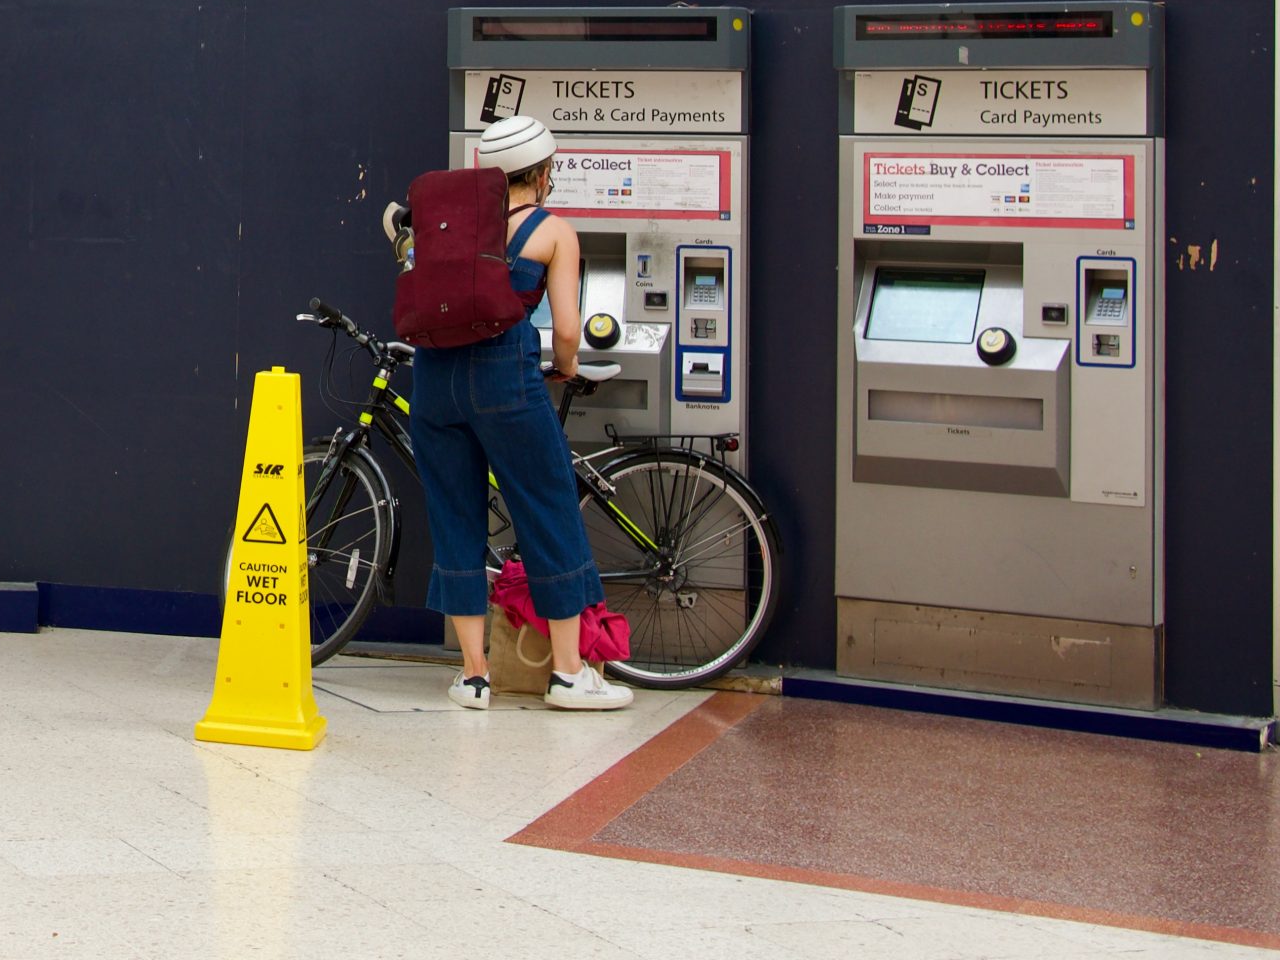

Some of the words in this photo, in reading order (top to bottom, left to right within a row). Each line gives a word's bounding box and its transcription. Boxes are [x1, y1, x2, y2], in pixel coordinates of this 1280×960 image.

[552, 81, 635, 98] TICKETS
[980, 81, 1068, 99] TICKETS
[552, 108, 588, 121] Cash
[594, 109, 605, 122] &
[611, 109, 645, 122] Card
[652, 109, 725, 125] Payments
[980, 110, 1017, 124] Card
[1023, 110, 1102, 127] Payments
[568, 158, 577, 170] &
[581, 158, 632, 170] Collect
[874, 163, 925, 175] Tickets
[930, 164, 957, 178] Buy
[961, 164, 971, 176] &
[975, 163, 1029, 176] Collect
[874, 180, 897, 188] Select
[874, 192, 897, 200] Make
[898, 193, 934, 201] payment
[874, 204, 901, 212] Collect
[877, 225, 900, 233] Zone
[254, 463, 284, 475] SIR
[239, 562, 287, 574] CAUTION
[247, 575, 278, 589] WET
[236, 590, 287, 606] FLOOR
